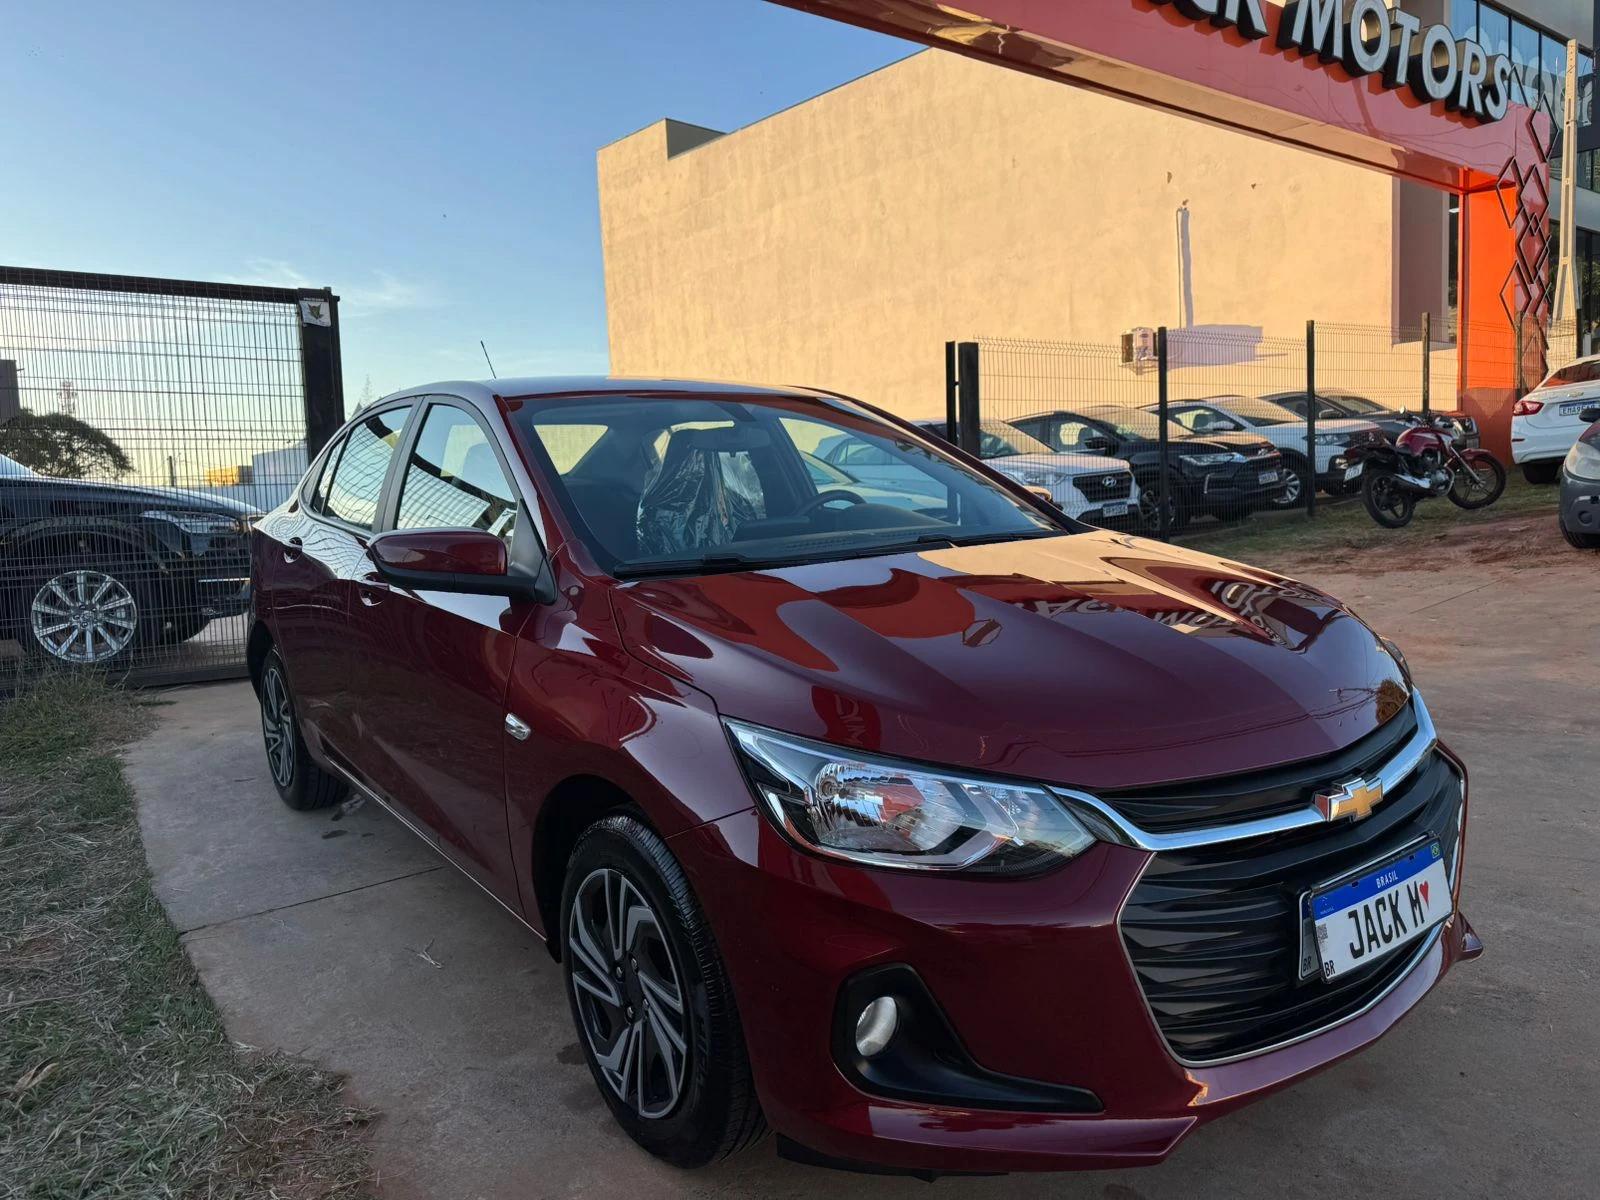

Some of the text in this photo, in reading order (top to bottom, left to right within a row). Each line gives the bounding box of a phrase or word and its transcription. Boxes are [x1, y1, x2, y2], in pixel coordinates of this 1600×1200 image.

[1290, 0, 1513, 120] MOTORS
[1376, 871, 1398, 888] BRASIL
[1348, 881, 1425, 959] JACK M
[1302, 956, 1312, 972] BR
[1324, 959, 1336, 978] BR
